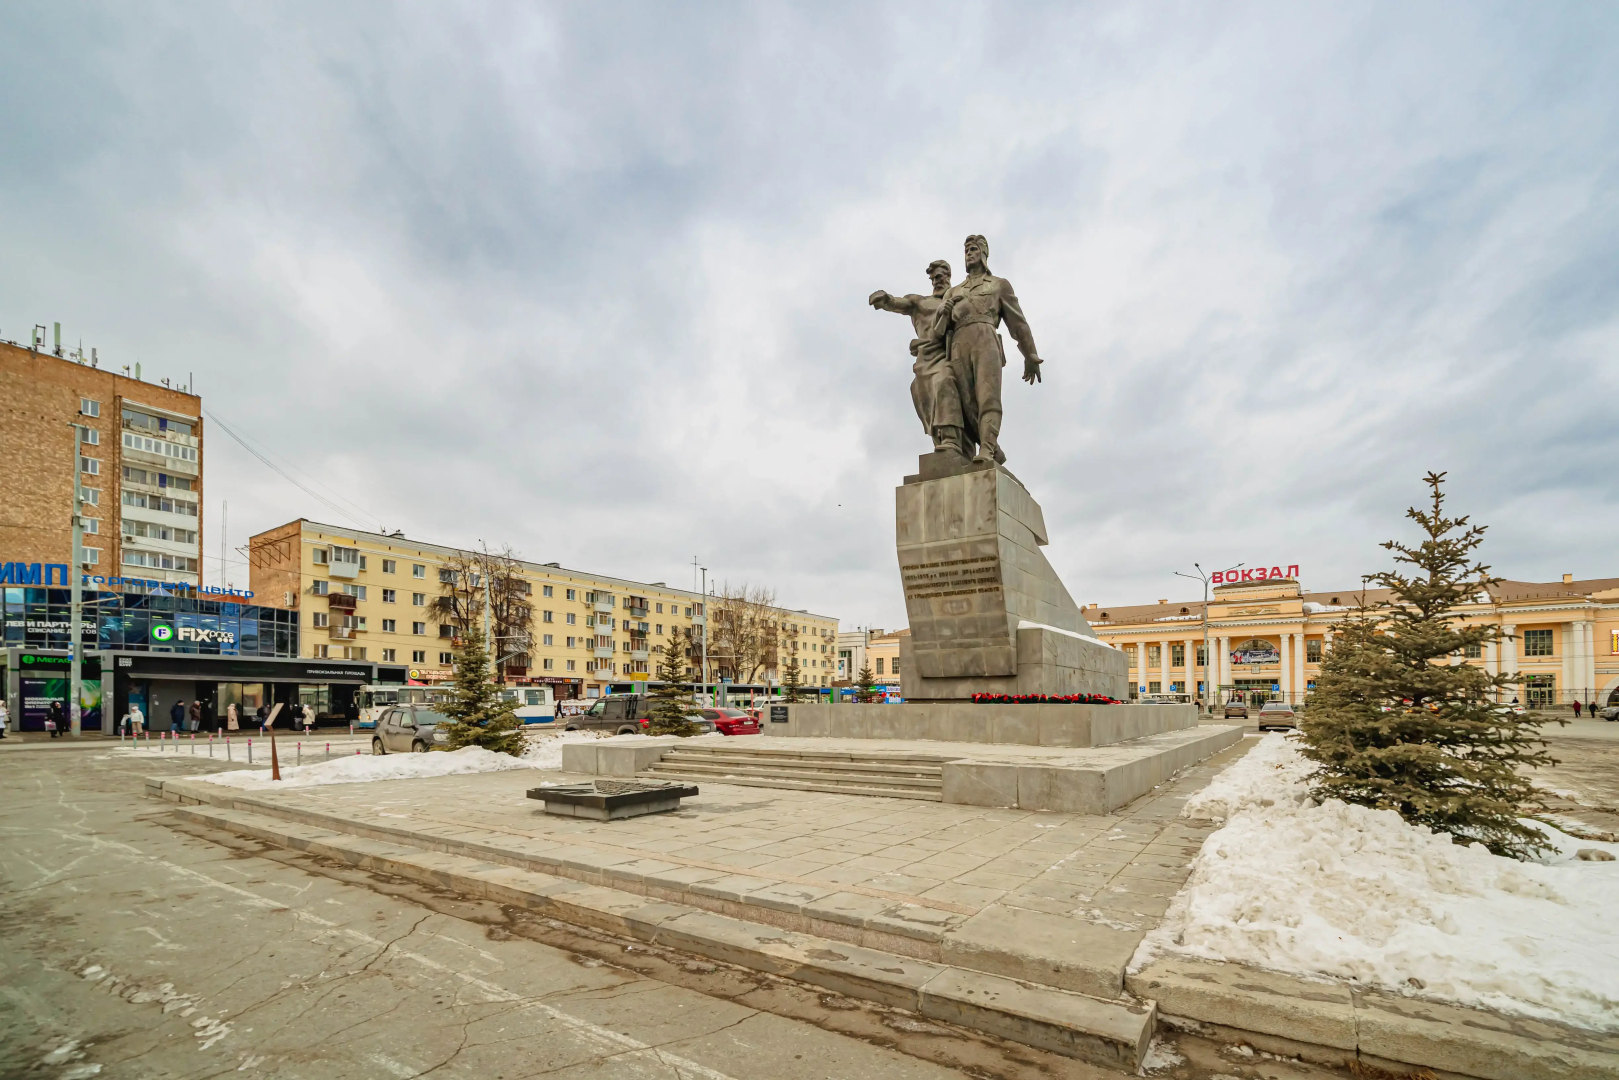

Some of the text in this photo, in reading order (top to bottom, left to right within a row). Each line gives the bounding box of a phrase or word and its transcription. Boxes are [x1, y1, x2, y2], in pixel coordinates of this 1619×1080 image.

[1212, 565, 1299, 583] ВОКЗАЛ
[82, 574, 255, 600] торговый центр
[37, 621, 97, 629] ПАРТНРЫ
